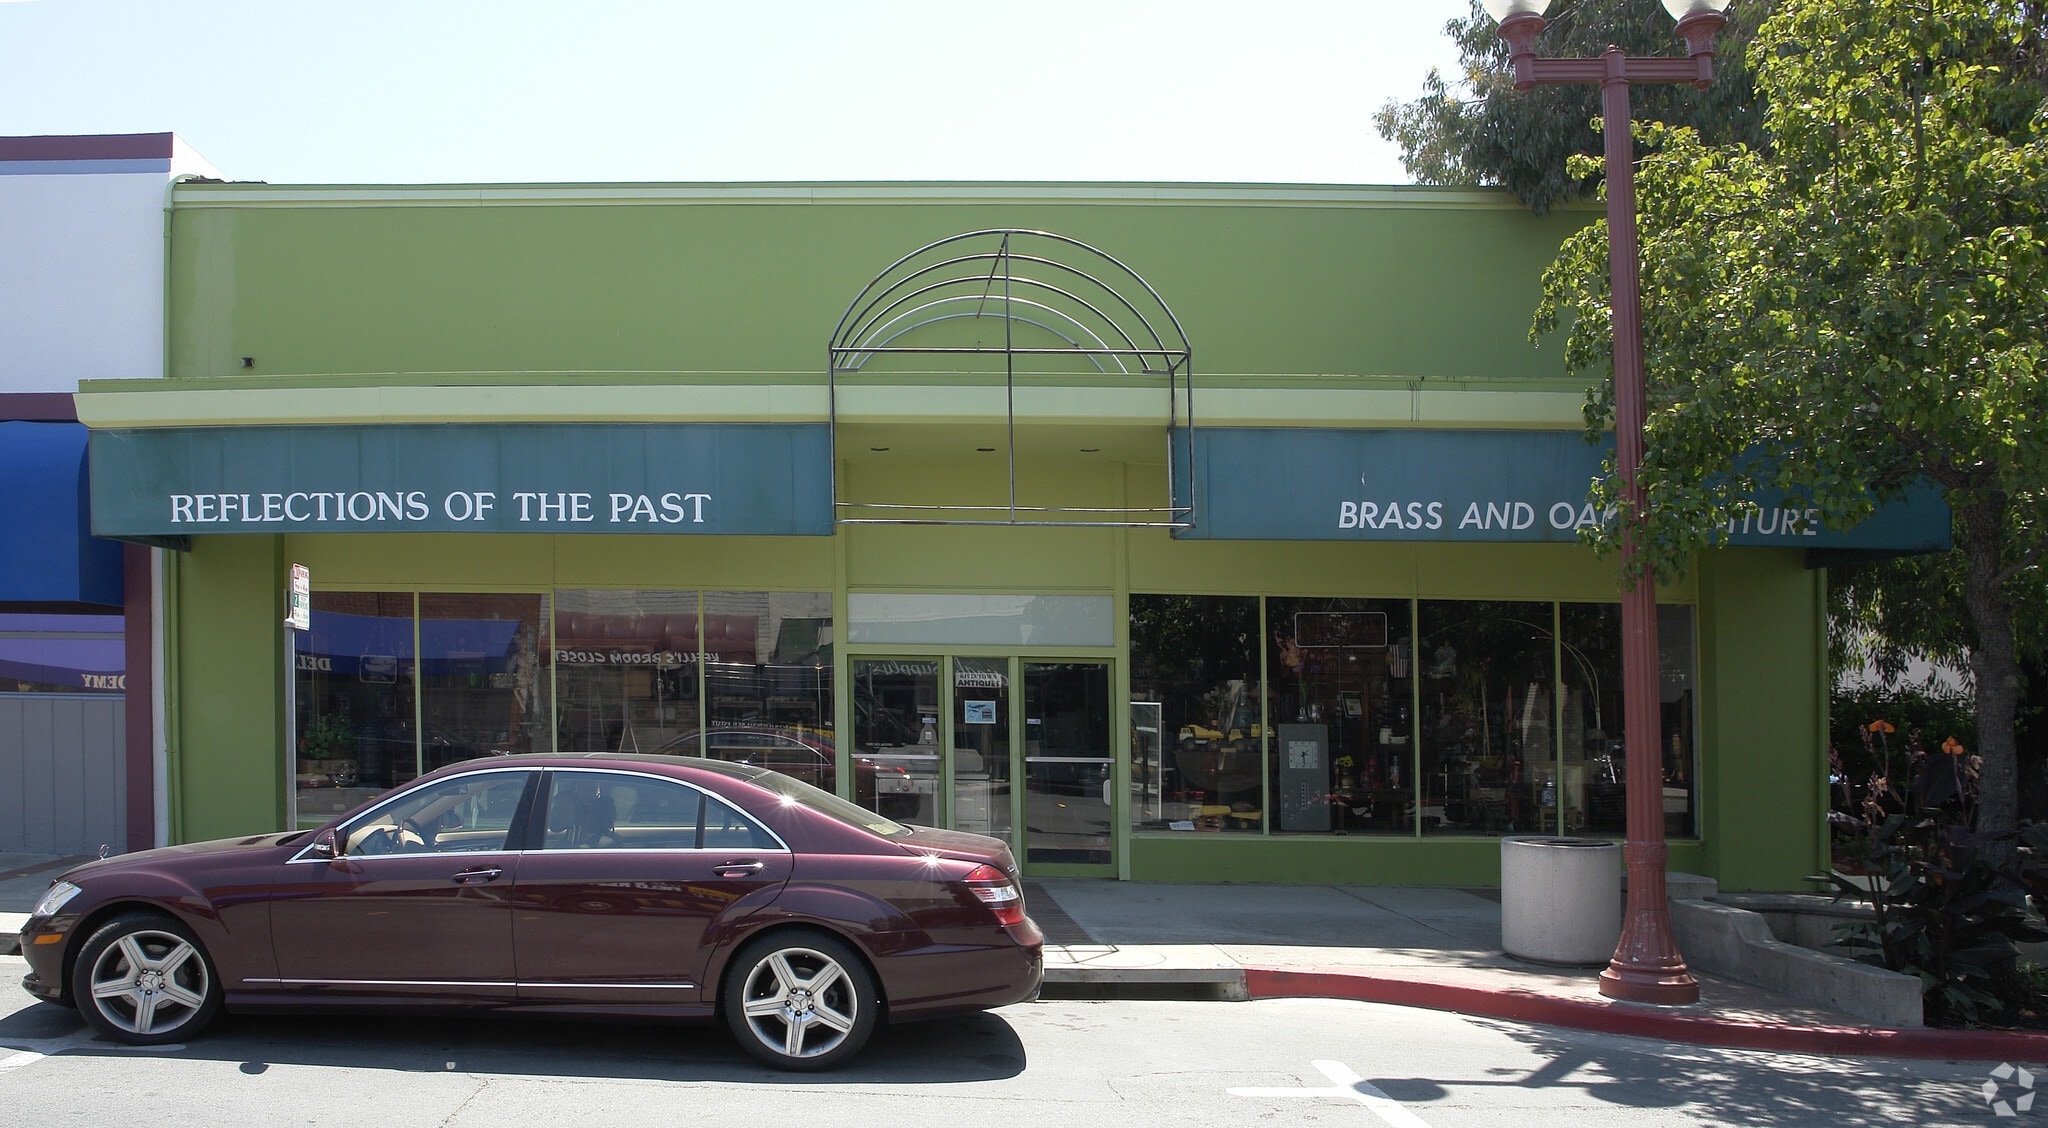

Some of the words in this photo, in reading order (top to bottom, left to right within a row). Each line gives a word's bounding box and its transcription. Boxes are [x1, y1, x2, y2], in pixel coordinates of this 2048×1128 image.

[170, 491, 429, 523] REFLECTIONS
[444, 490, 496, 522] OF
[512, 490, 593, 522] THE
[608, 491, 712, 522] PAST
[1338, 501, 1442, 529] BRASS
[1459, 502, 1535, 530] AND
[957, 680, 1000, 688] ANTIQUES
